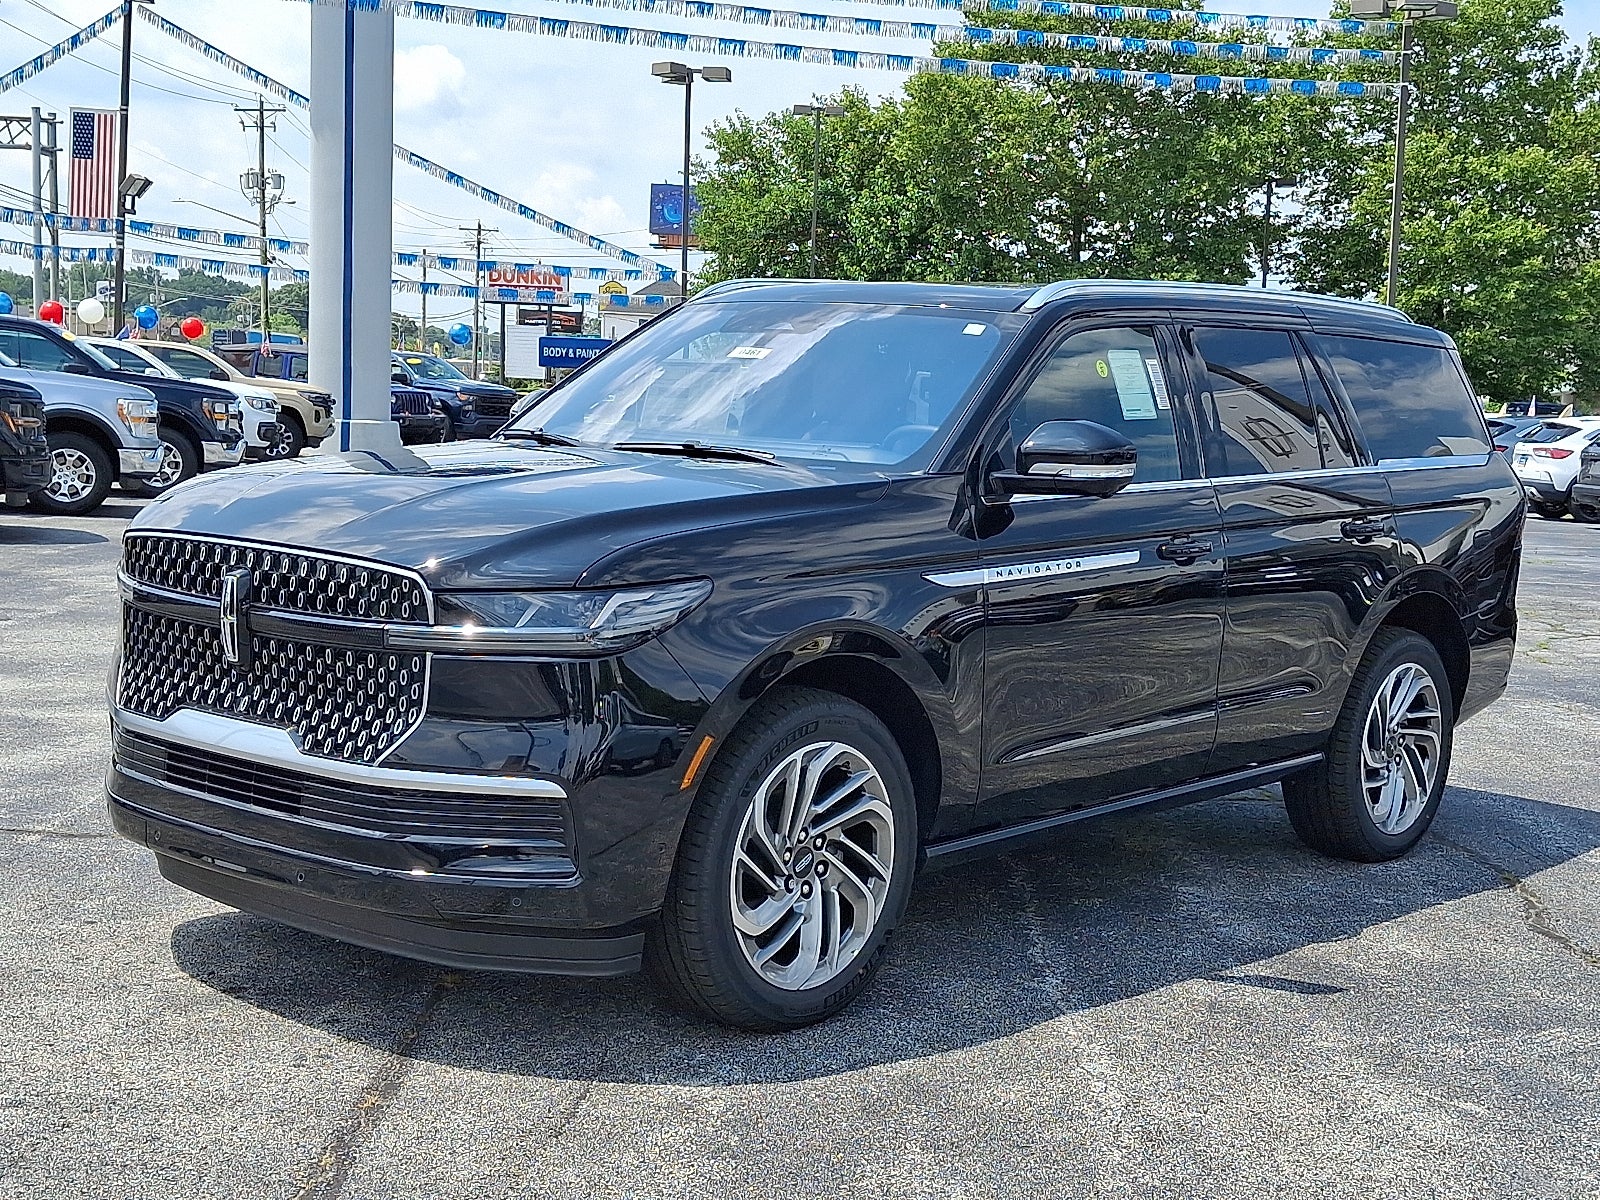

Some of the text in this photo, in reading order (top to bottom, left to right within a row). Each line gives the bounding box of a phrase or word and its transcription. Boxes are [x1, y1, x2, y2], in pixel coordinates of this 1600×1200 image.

[543, 347, 567, 357] BODY
[568, 348, 575, 358] &
[996, 560, 1082, 578] NAVIGATOR
